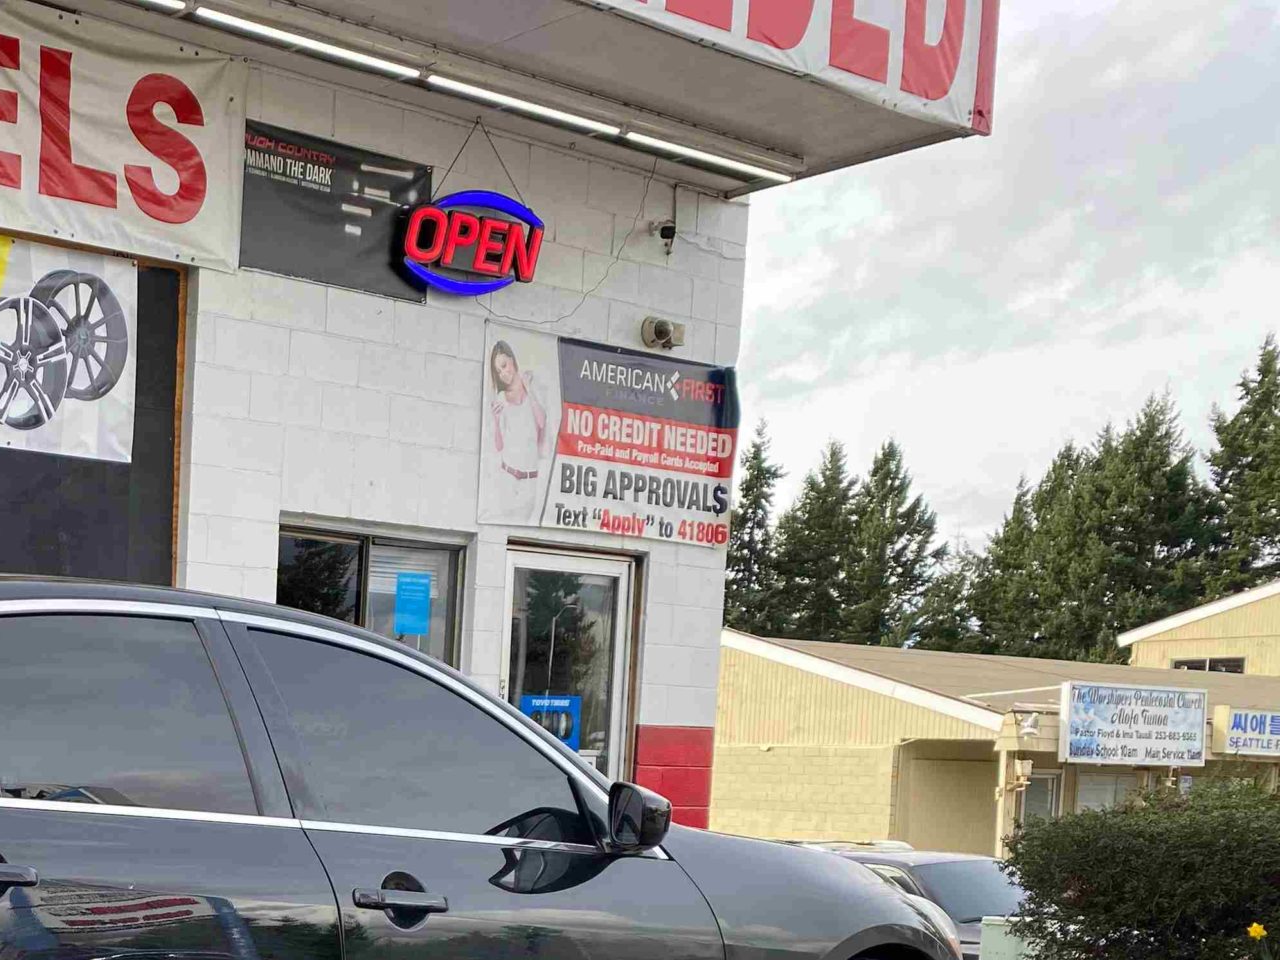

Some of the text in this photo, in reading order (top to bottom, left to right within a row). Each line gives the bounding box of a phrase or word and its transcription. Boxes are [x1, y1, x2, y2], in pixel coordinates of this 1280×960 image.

[278, 142, 336, 165] COUNTRY
[285, 159, 304, 179] THE
[306, 163, 332, 186] DARK
[404, 205, 544, 283] OPEN
[580, 359, 725, 404] AMERICAN FIRST
[567, 408, 733, 458] NO CREDIT NEEDED
[577, 440, 719, 473] Pre-Paid and Payroll Cards Accepted
[560, 462, 728, 518] BIG APPROVAL$
[555, 503, 589, 528] Text
[658, 516, 674, 539] to
[677, 519, 728, 545] 41806
[1072, 686, 1087, 704] The
[1177, 692, 1202, 709] Church
[1074, 728, 1096, 738] Pastor
[1097, 728, 1115, 740] Floyd
[1115, 729, 1121, 738] &
[1228, 736, 1273, 750] SEATTLE
[1069, 742, 1094, 757] Sunday
